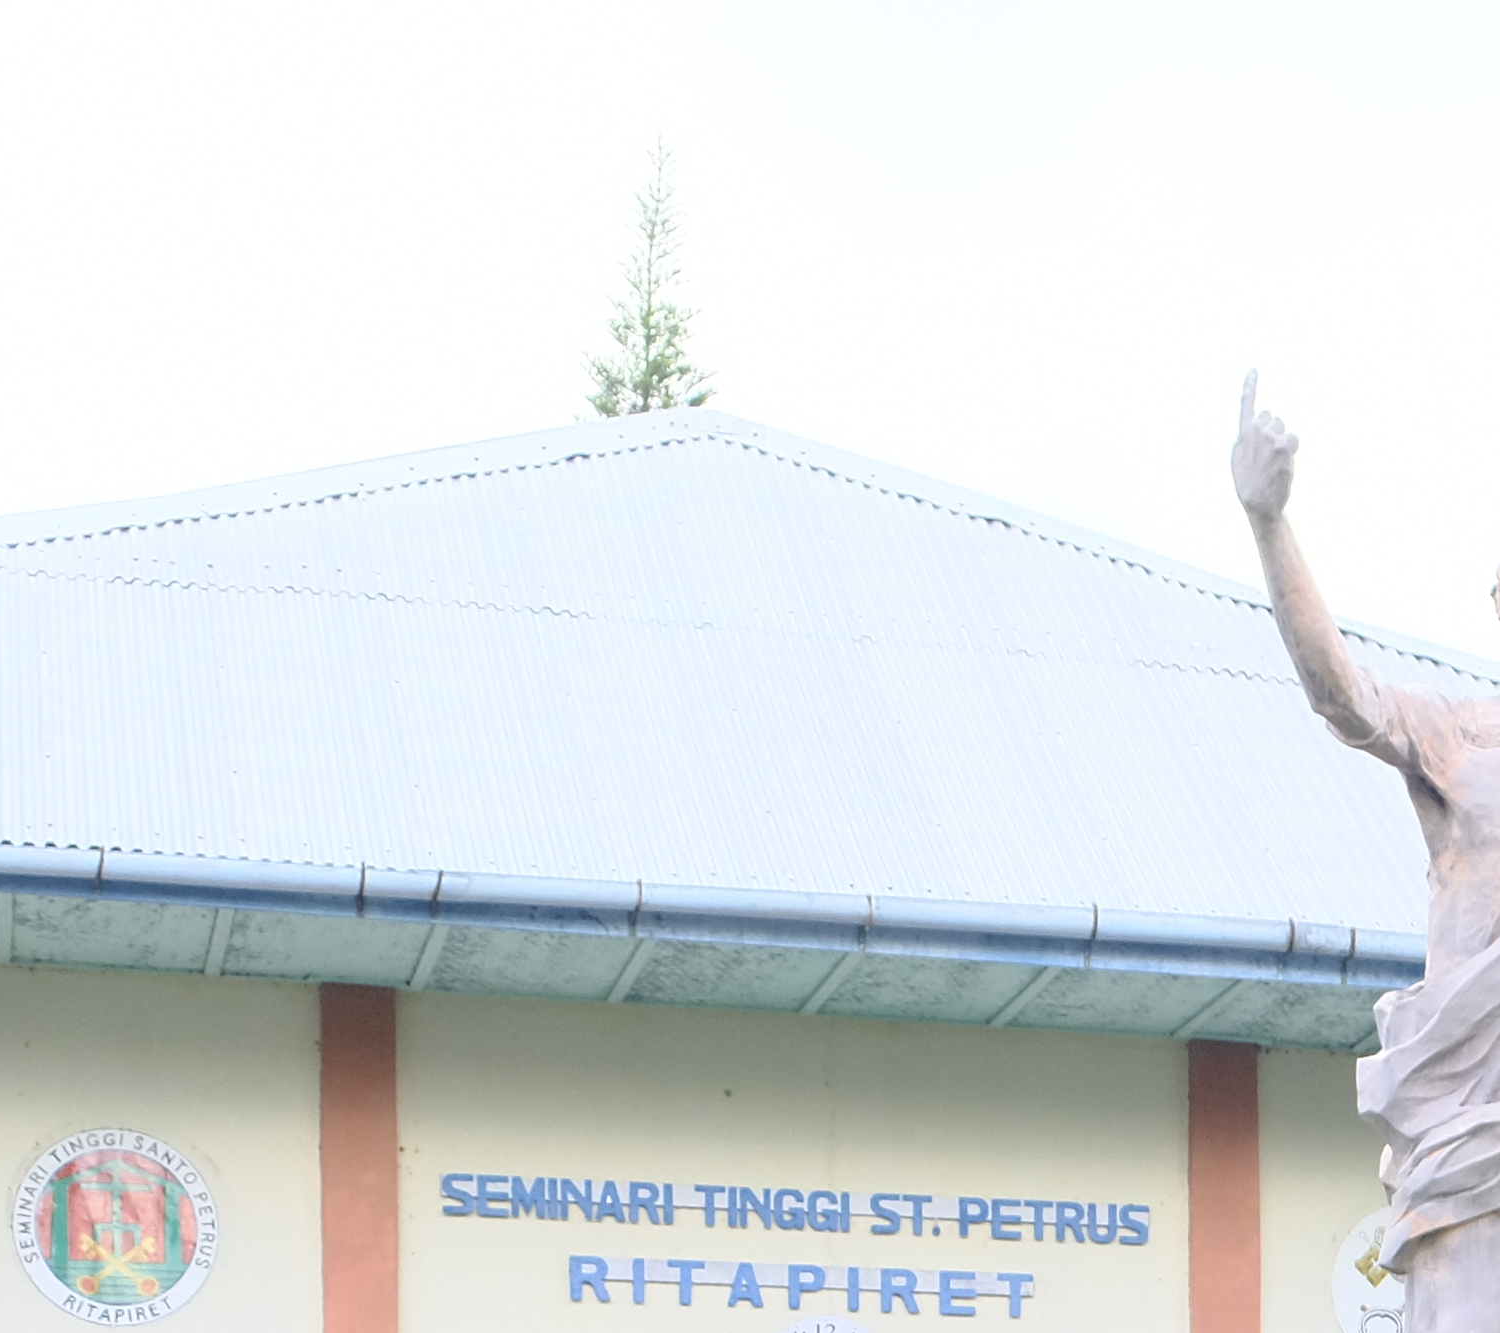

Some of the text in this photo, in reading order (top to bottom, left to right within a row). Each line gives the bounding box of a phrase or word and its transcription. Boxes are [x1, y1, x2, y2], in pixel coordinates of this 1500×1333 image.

[16, 1132, 217, 1269] SEMINARI TINGGI SANTO PETRUS
[442, 1172, 1150, 1246] SEMINARI TINGGI ST. PETRUS
[62, 1294, 172, 1324] RITAPIRET
[568, 1254, 1035, 1320] RITAPIRET
